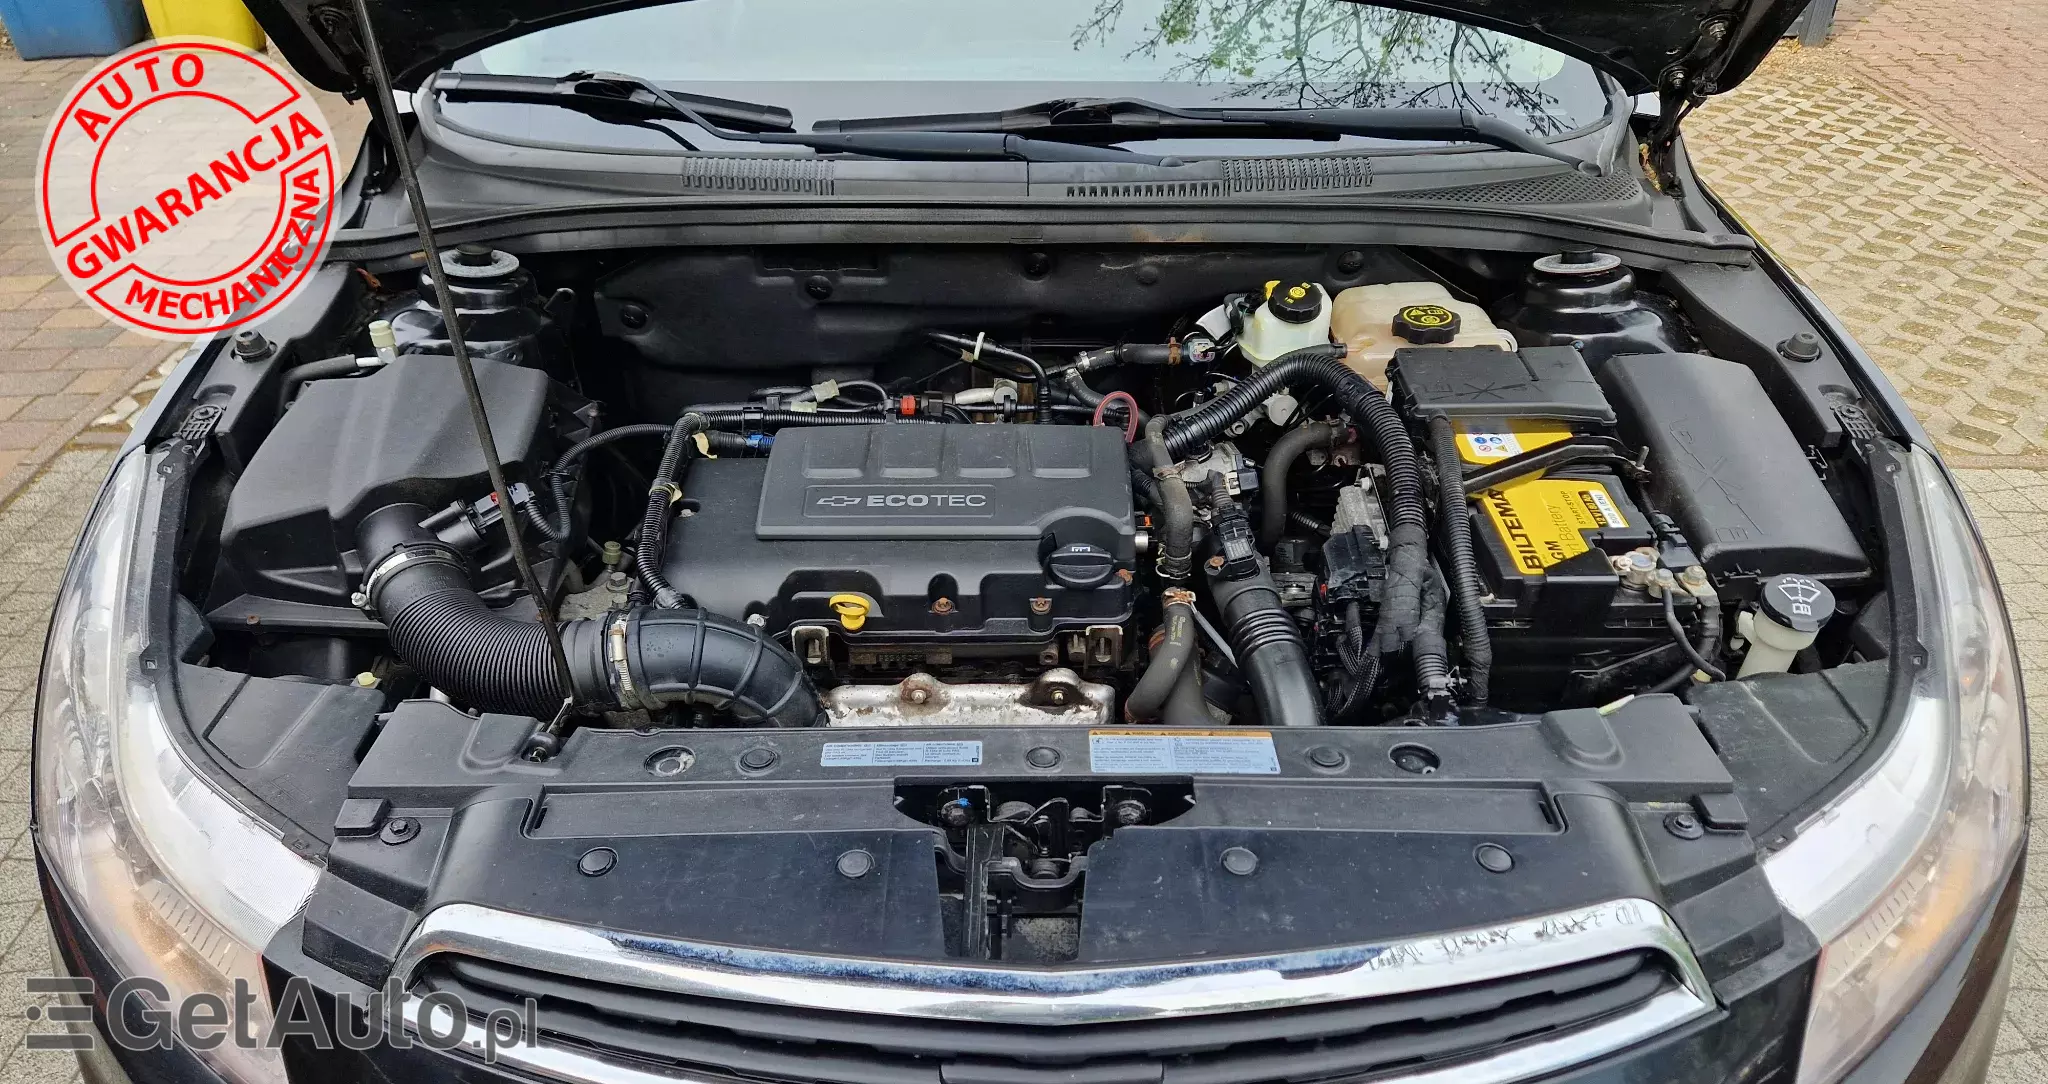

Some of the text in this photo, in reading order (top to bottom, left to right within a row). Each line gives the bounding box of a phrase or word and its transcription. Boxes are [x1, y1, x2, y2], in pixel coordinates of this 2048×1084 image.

[866, 494, 987, 508] ECOTEC
[1488, 488, 1546, 570] BILTEMA
[1547, 504, 1576, 541] Battery
[1544, 540, 1568, 561] GM
